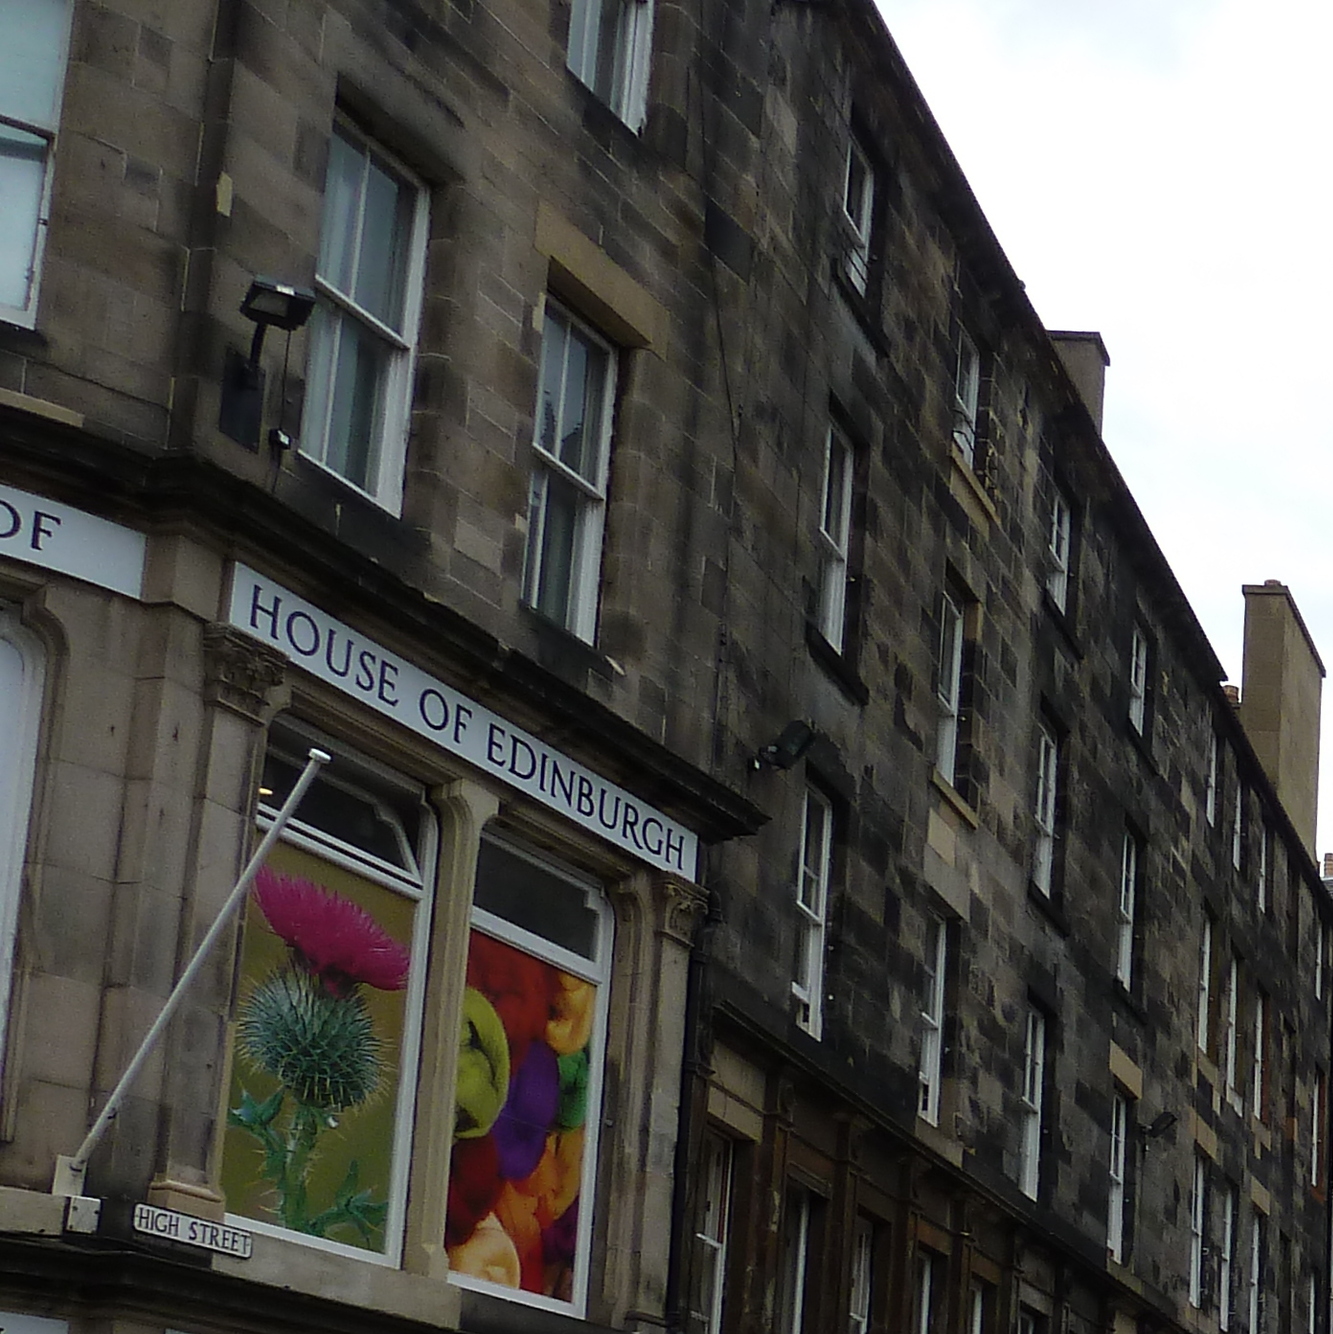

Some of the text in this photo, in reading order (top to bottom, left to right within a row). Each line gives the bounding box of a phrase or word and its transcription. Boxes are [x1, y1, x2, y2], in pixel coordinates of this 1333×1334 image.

[250, 584, 685, 871] HOUSE OF EDINBURGH
[138, 1206, 251, 1255] HIGH STREET
